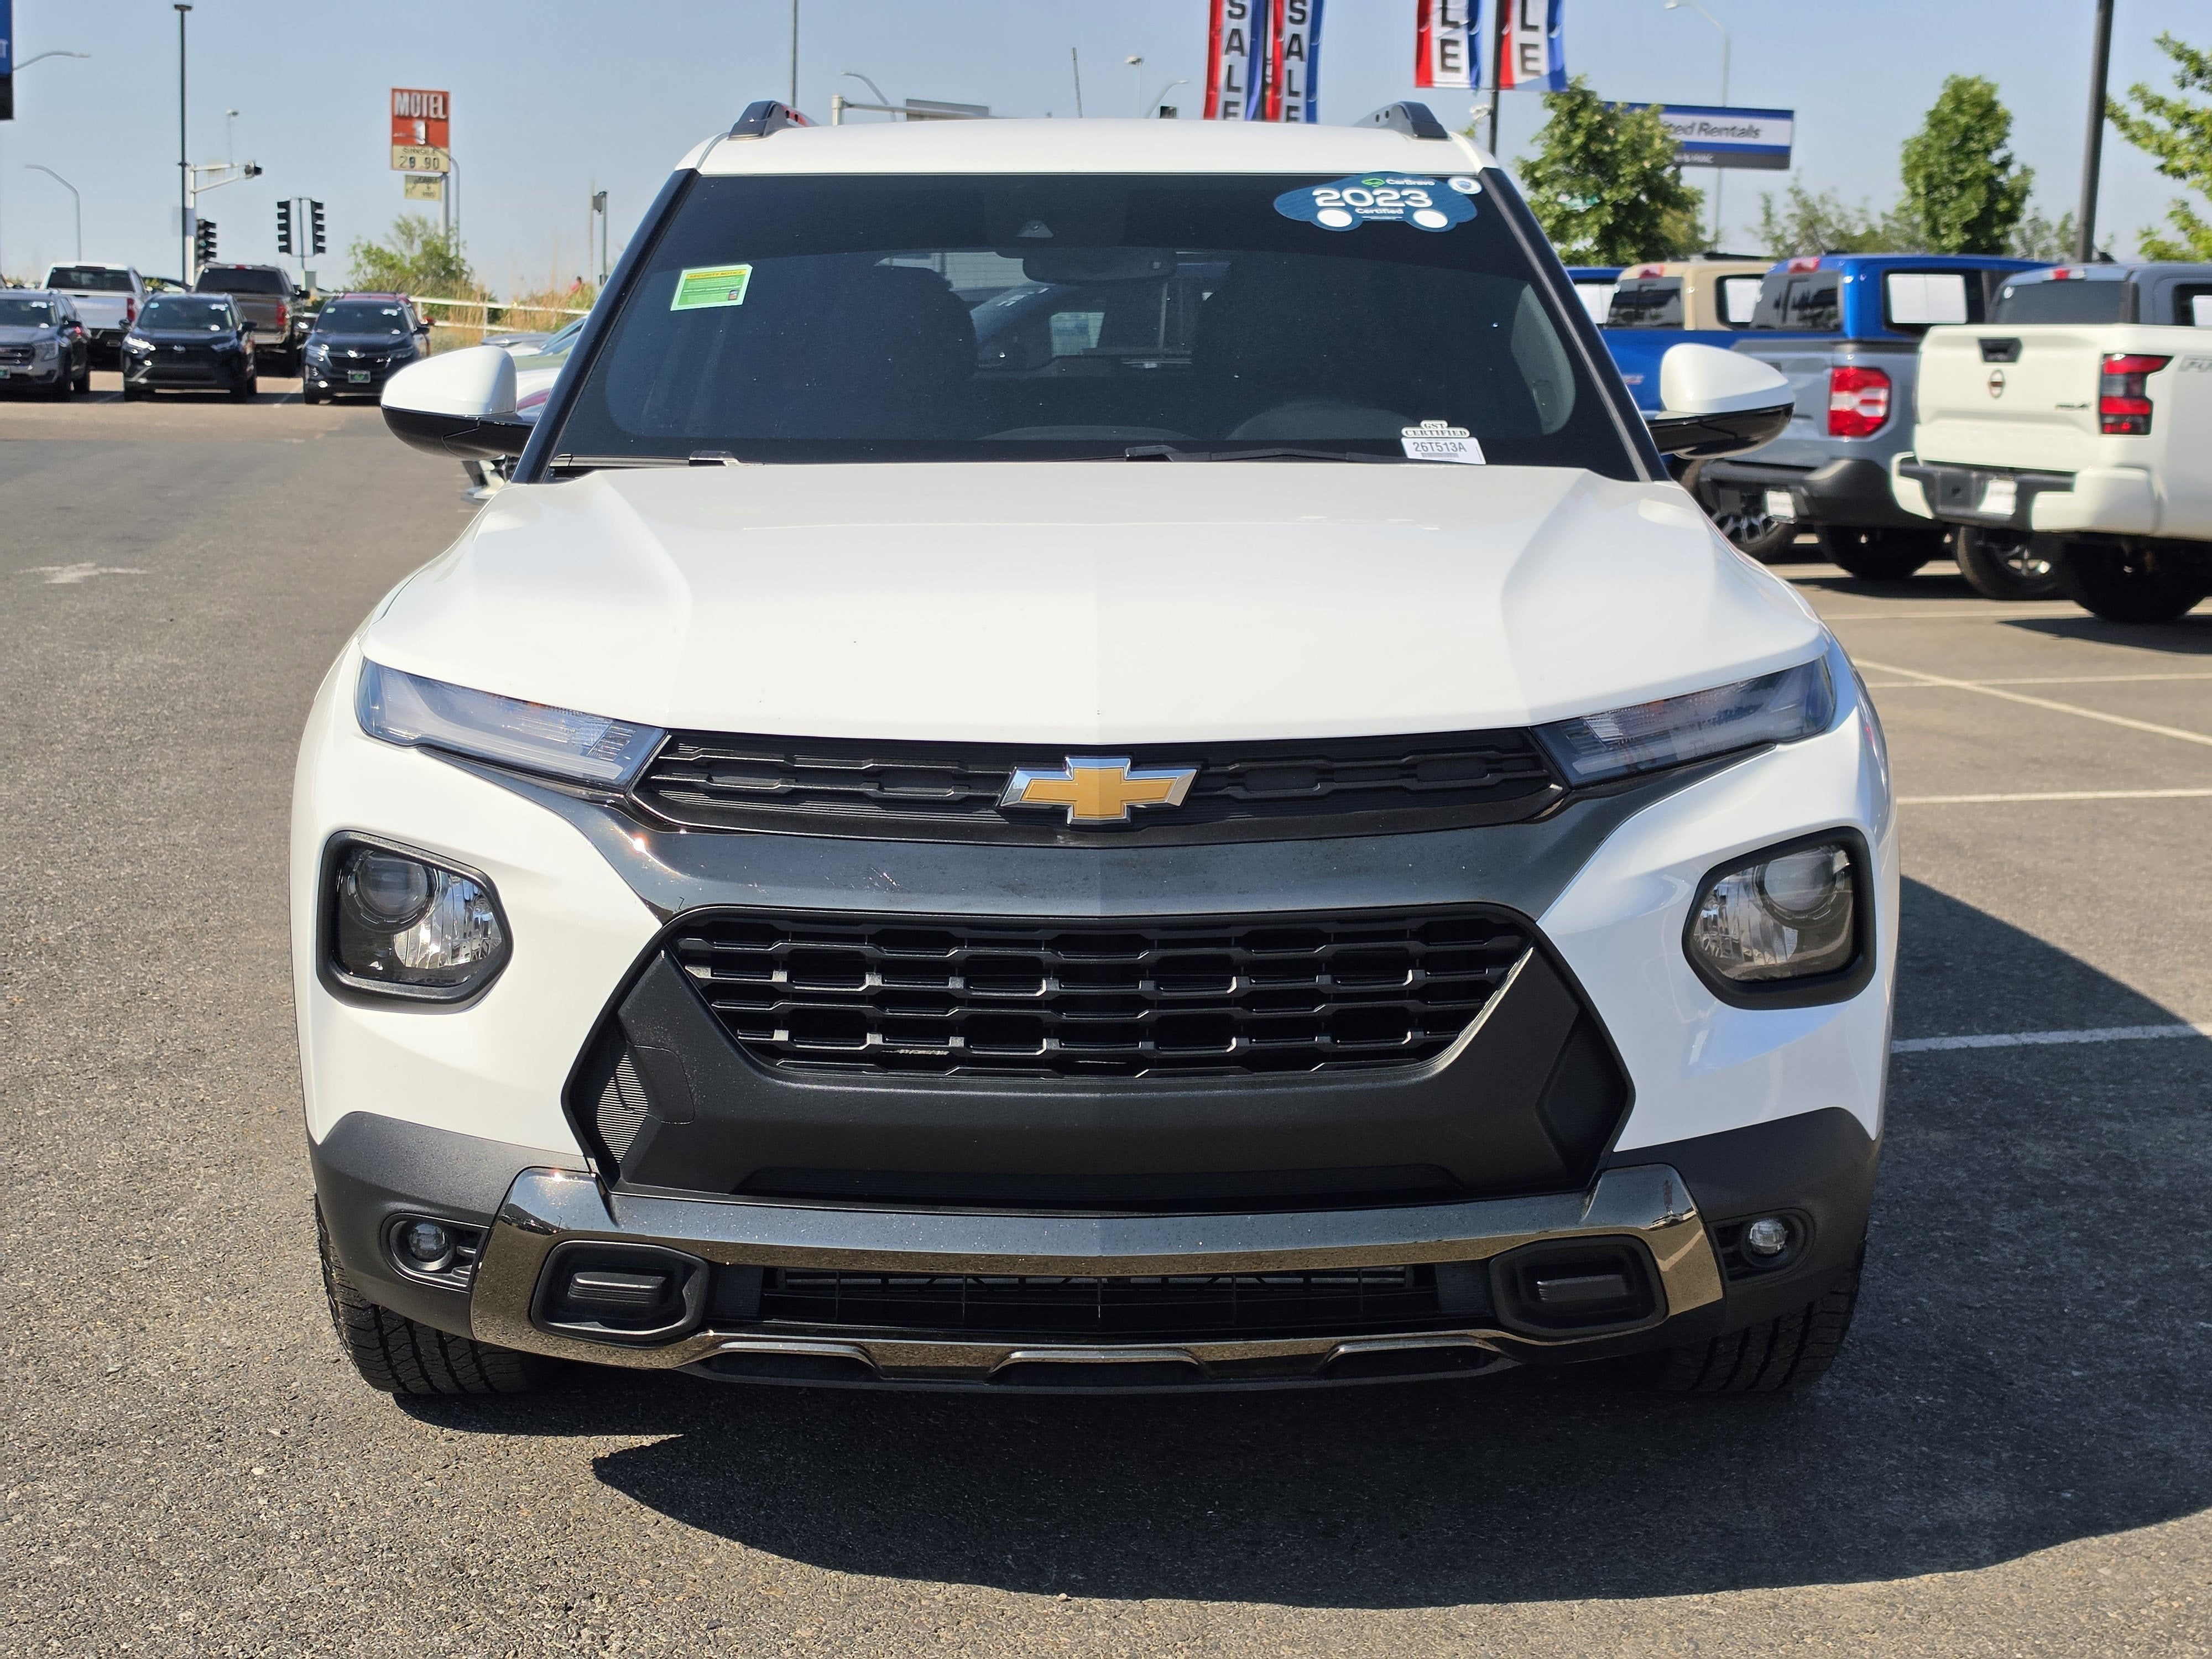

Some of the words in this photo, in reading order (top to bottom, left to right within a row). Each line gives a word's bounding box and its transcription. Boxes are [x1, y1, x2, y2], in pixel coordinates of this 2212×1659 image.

[1440, 0, 1461, 73] LE
[1520, 0, 1541, 76] LE
[395, 92, 447, 119] MOTEL
[1698, 122, 1761, 138] Rentals
[1312, 187, 1433, 207] 2023
[1412, 441, 1467, 452] 26T513A
